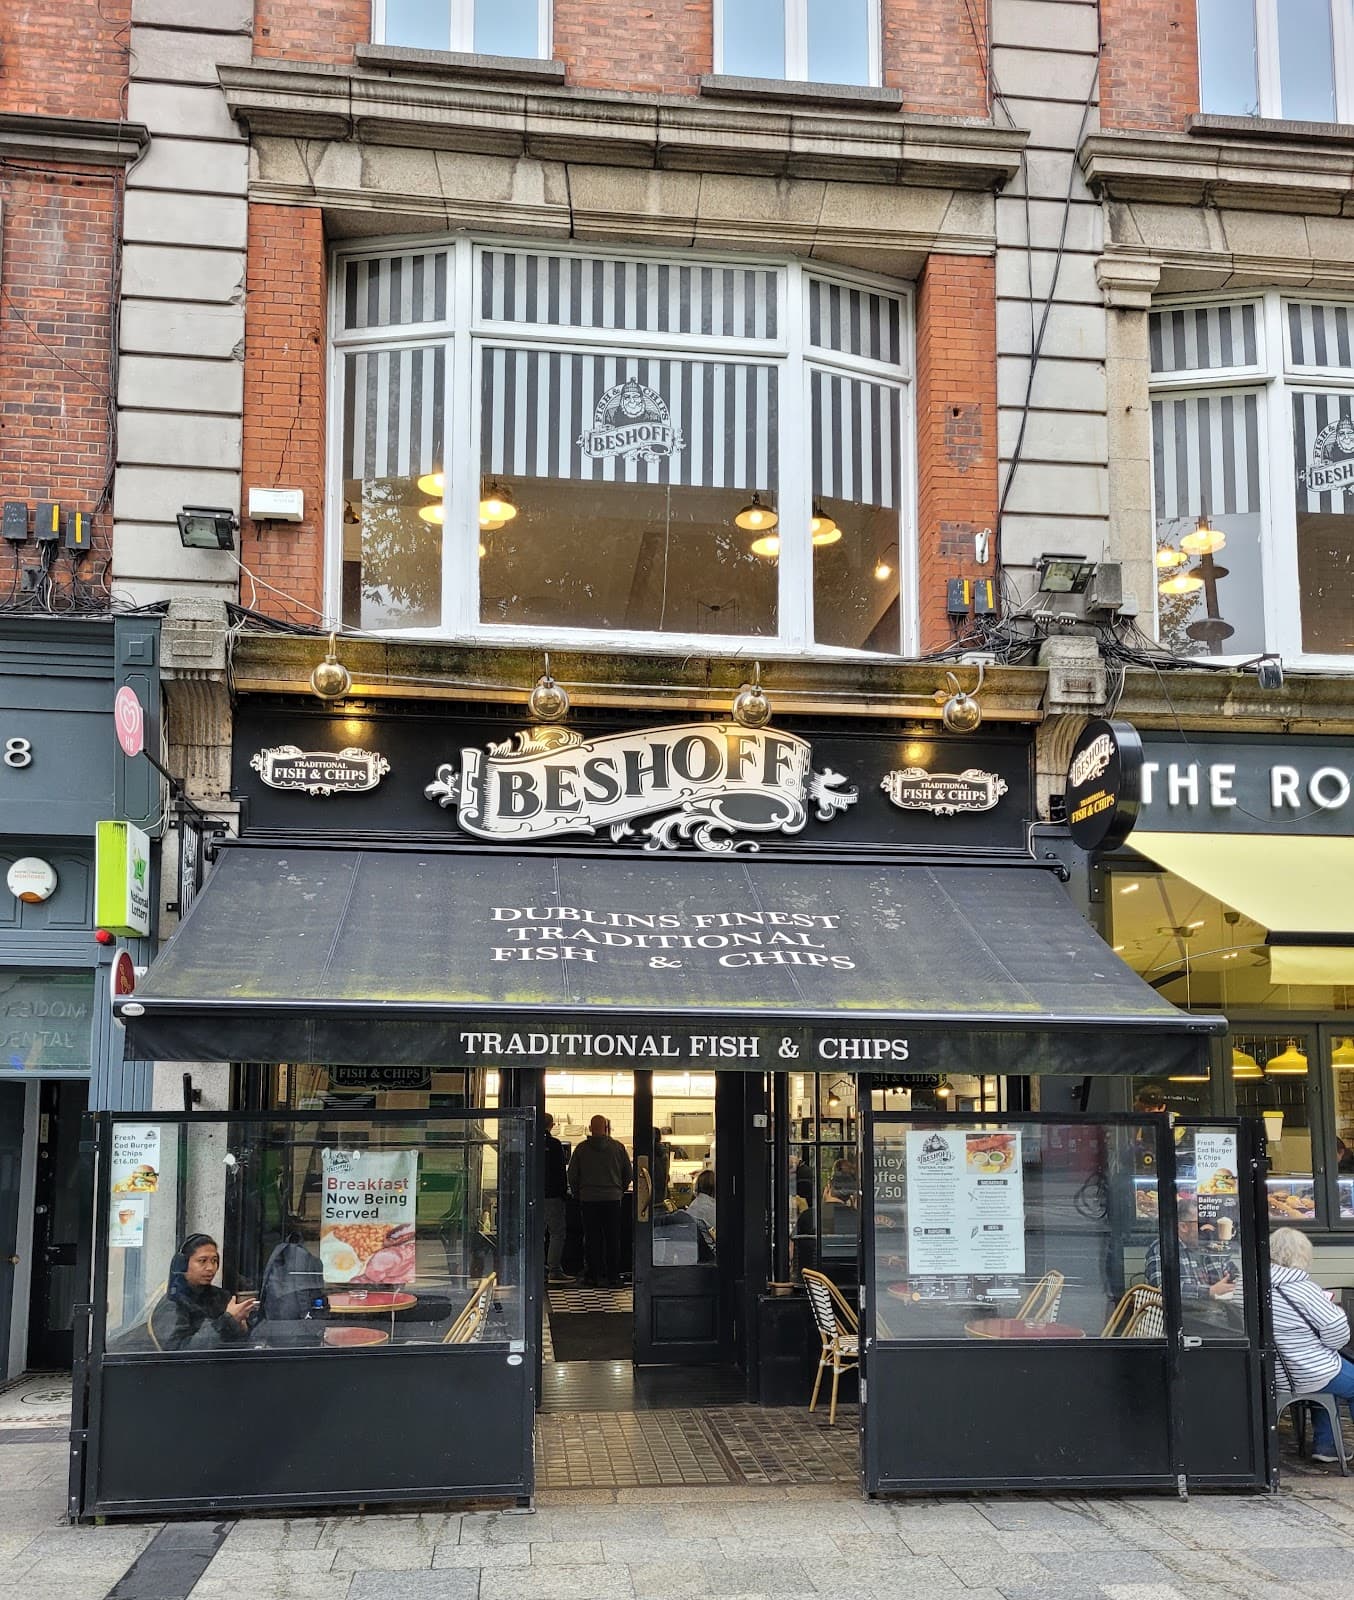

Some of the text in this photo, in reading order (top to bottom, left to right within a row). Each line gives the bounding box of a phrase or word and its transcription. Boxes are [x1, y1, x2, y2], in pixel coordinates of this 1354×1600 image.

[595, 394, 612, 422] FISH
[643, 387, 669, 421] CHIPS
[594, 425, 670, 452] BESHOFF
[1314, 431, 1328, 459] FISH
[1314, 463, 1353, 486] BESH
[4, 737, 31, 767] 8
[1076, 737, 1108, 778] BESHOFF
[274, 767, 367, 780] FISH & CHIPS
[294, 761, 348, 769] TRADITIONAL
[496, 734, 796, 819] BESHOFF
[903, 788, 987, 801] FISH & CHIPS
[921, 782, 970, 790] TRADITIONAL
[1141, 762, 1351, 809] THE RO
[1071, 793, 1115, 824] FISH & CHIPS
[130, 888, 149, 908] National
[131, 902, 148, 924] Lottery
[490, 906, 841, 929] DUBLINS FINEST
[507, 926, 826, 949] TRADITIONAL
[490, 946, 856, 970] FISH & CHIPS
[460, 1031, 909, 1060] TRADITIONAL FISH & CHIPS
[340, 1067, 420, 1079] FISH & CHIPS
[130, 1142, 157, 1150] Burger
[327, 1177, 409, 1191] Breakfast
[326, 1192, 407, 1207] Now Being
[1198, 1197, 1223, 1205] Baileys
[325, 1207, 379, 1219] Served
